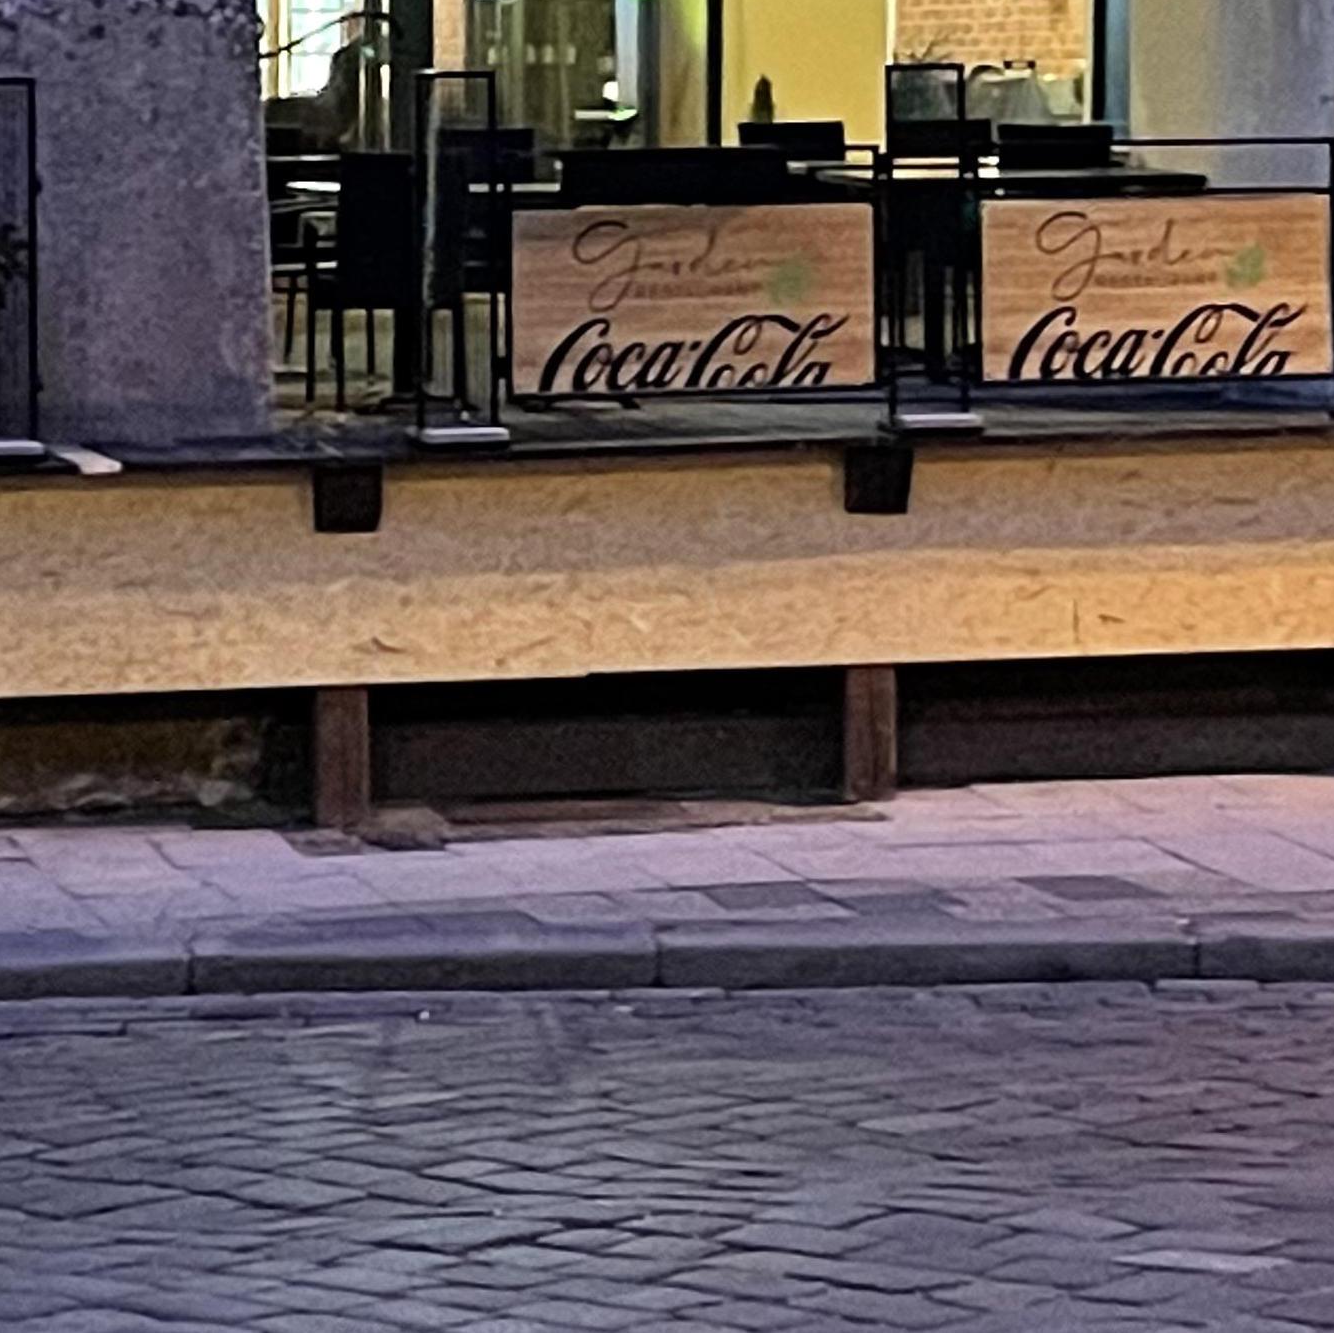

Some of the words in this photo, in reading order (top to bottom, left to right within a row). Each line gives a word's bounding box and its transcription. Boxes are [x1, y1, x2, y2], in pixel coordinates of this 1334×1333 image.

[1035, 211, 1229, 301] Garden
[538, 313, 850, 393] Coca-Cola
[1008, 303, 1308, 380] Coca-Cola
